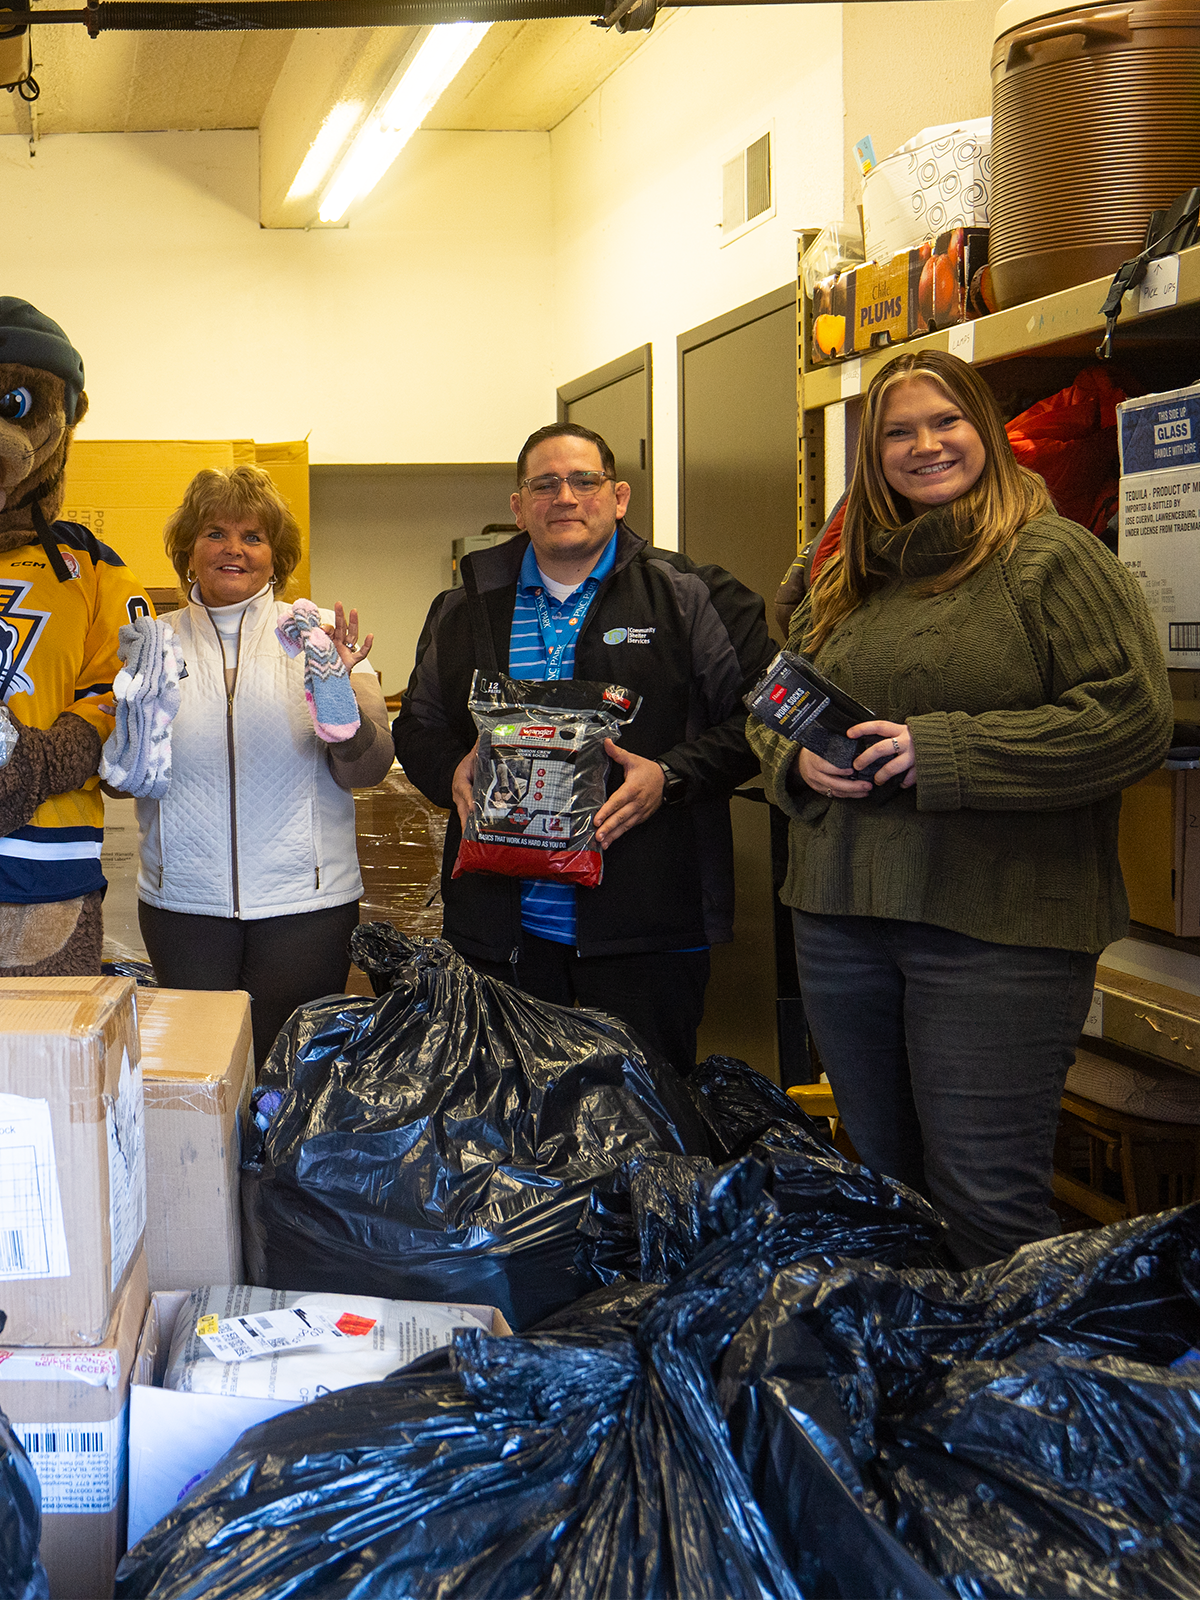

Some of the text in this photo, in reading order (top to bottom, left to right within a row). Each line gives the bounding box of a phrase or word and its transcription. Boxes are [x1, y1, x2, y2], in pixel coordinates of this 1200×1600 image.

[872, 281, 890, 300] Chile
[860, 296, 901, 328] PLUMS
[1158, 406, 1187, 421] THIS SIDE UP
[1157, 423, 1188, 441] GLASS
[1153, 442, 1197, 459] HANDLE WITH CARE
[1125, 489, 1148, 502] TEQUILA
[1152, 484, 1181, 498] PRODUCT
[1182, 482, 1191, 494] OF
[1125, 502, 1147, 513] IMPORTED
[1152, 499, 1173, 510] BOTTLED
[1173, 498, 1181, 508] BY
[1125, 516, 1135, 526] JOSE
[1125, 527, 1139, 537] UNDER
[1140, 526, 1158, 536] LICENSE
[1159, 524, 1173, 534] FROM
[10, 561, 47, 569] CCM
[537, 595, 552, 629] PNC PARK
[573, 600, 588, 617] PNC
[771, 688, 785, 700] Hanes
[774, 703, 791, 720] WORK
[787, 687, 805, 706] SOCKS
[478, 833, 494, 842] BASICS
[494, 835, 506, 843] THAT
[506, 836, 520, 844] WORK
[527, 839, 541, 847] HARD
[541, 840, 549, 848] AS
[549, 841, 559, 849] YOU
